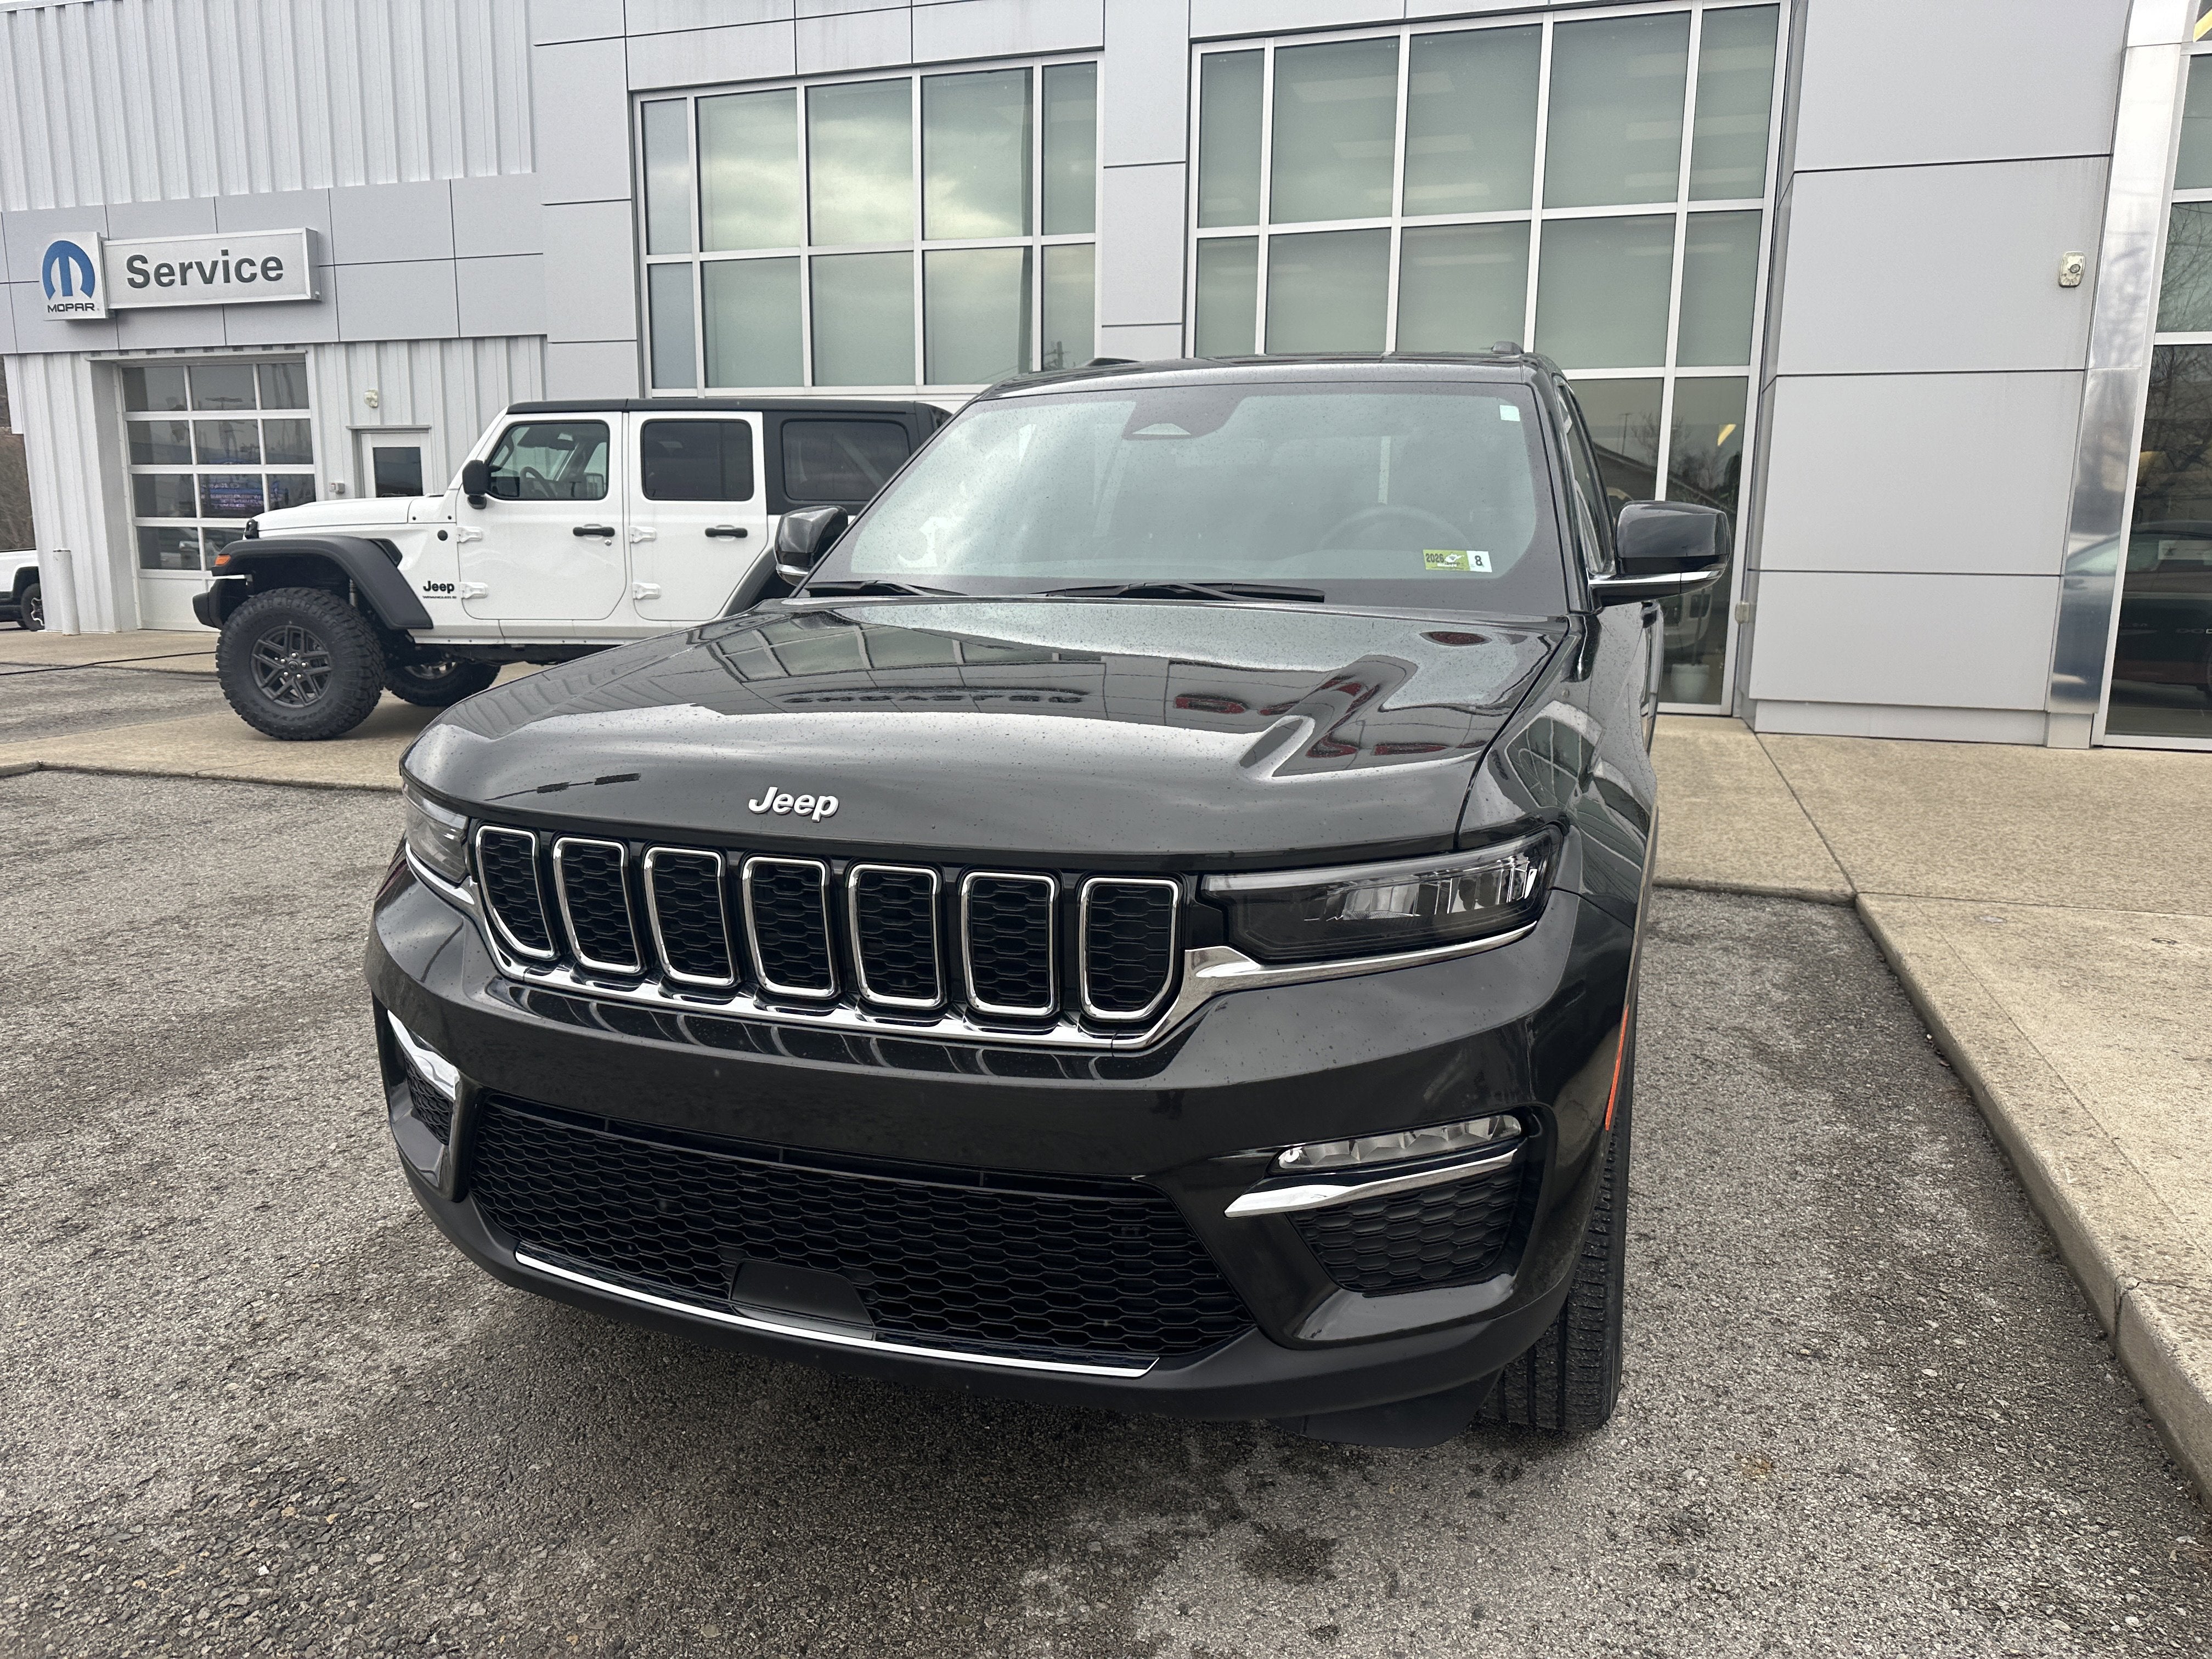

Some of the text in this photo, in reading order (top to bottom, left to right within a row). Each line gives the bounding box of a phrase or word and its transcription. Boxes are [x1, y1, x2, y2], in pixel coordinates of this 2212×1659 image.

[126, 249, 284, 289] Service
[47, 303, 95, 313] MOPAR
[1425, 553, 1444, 563] 2026
[1474, 555, 1483, 566] 8
[423, 580, 455, 594] Jeep
[748, 786, 839, 822] Jeep
